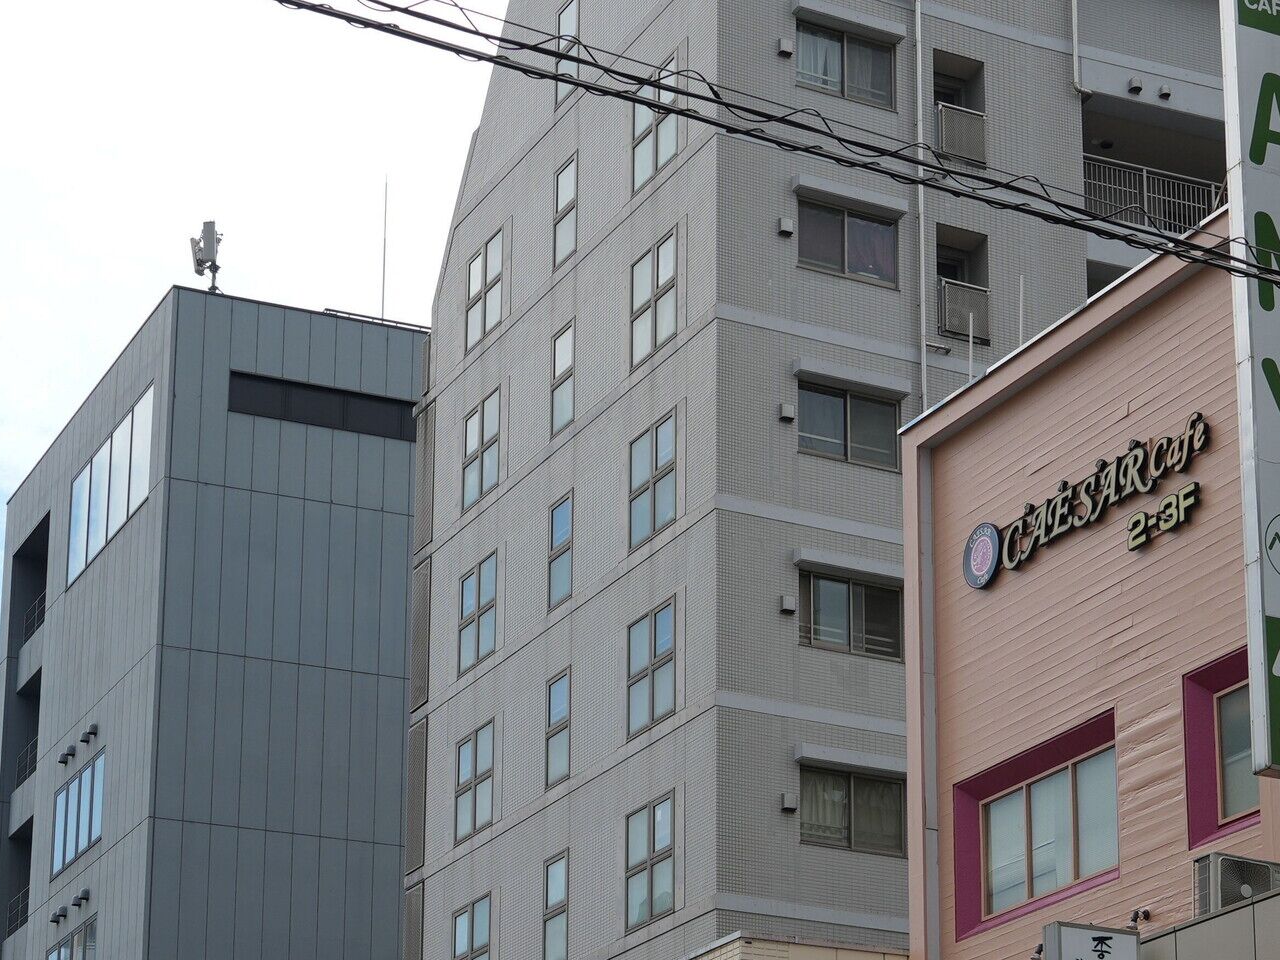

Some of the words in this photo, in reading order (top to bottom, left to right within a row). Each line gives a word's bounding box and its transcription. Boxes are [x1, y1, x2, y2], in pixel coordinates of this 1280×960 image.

[1003, 447, 1154, 571] CAESAR
[1150, 411, 1208, 479] Cafe
[1127, 482, 1201, 551] 2-3F
